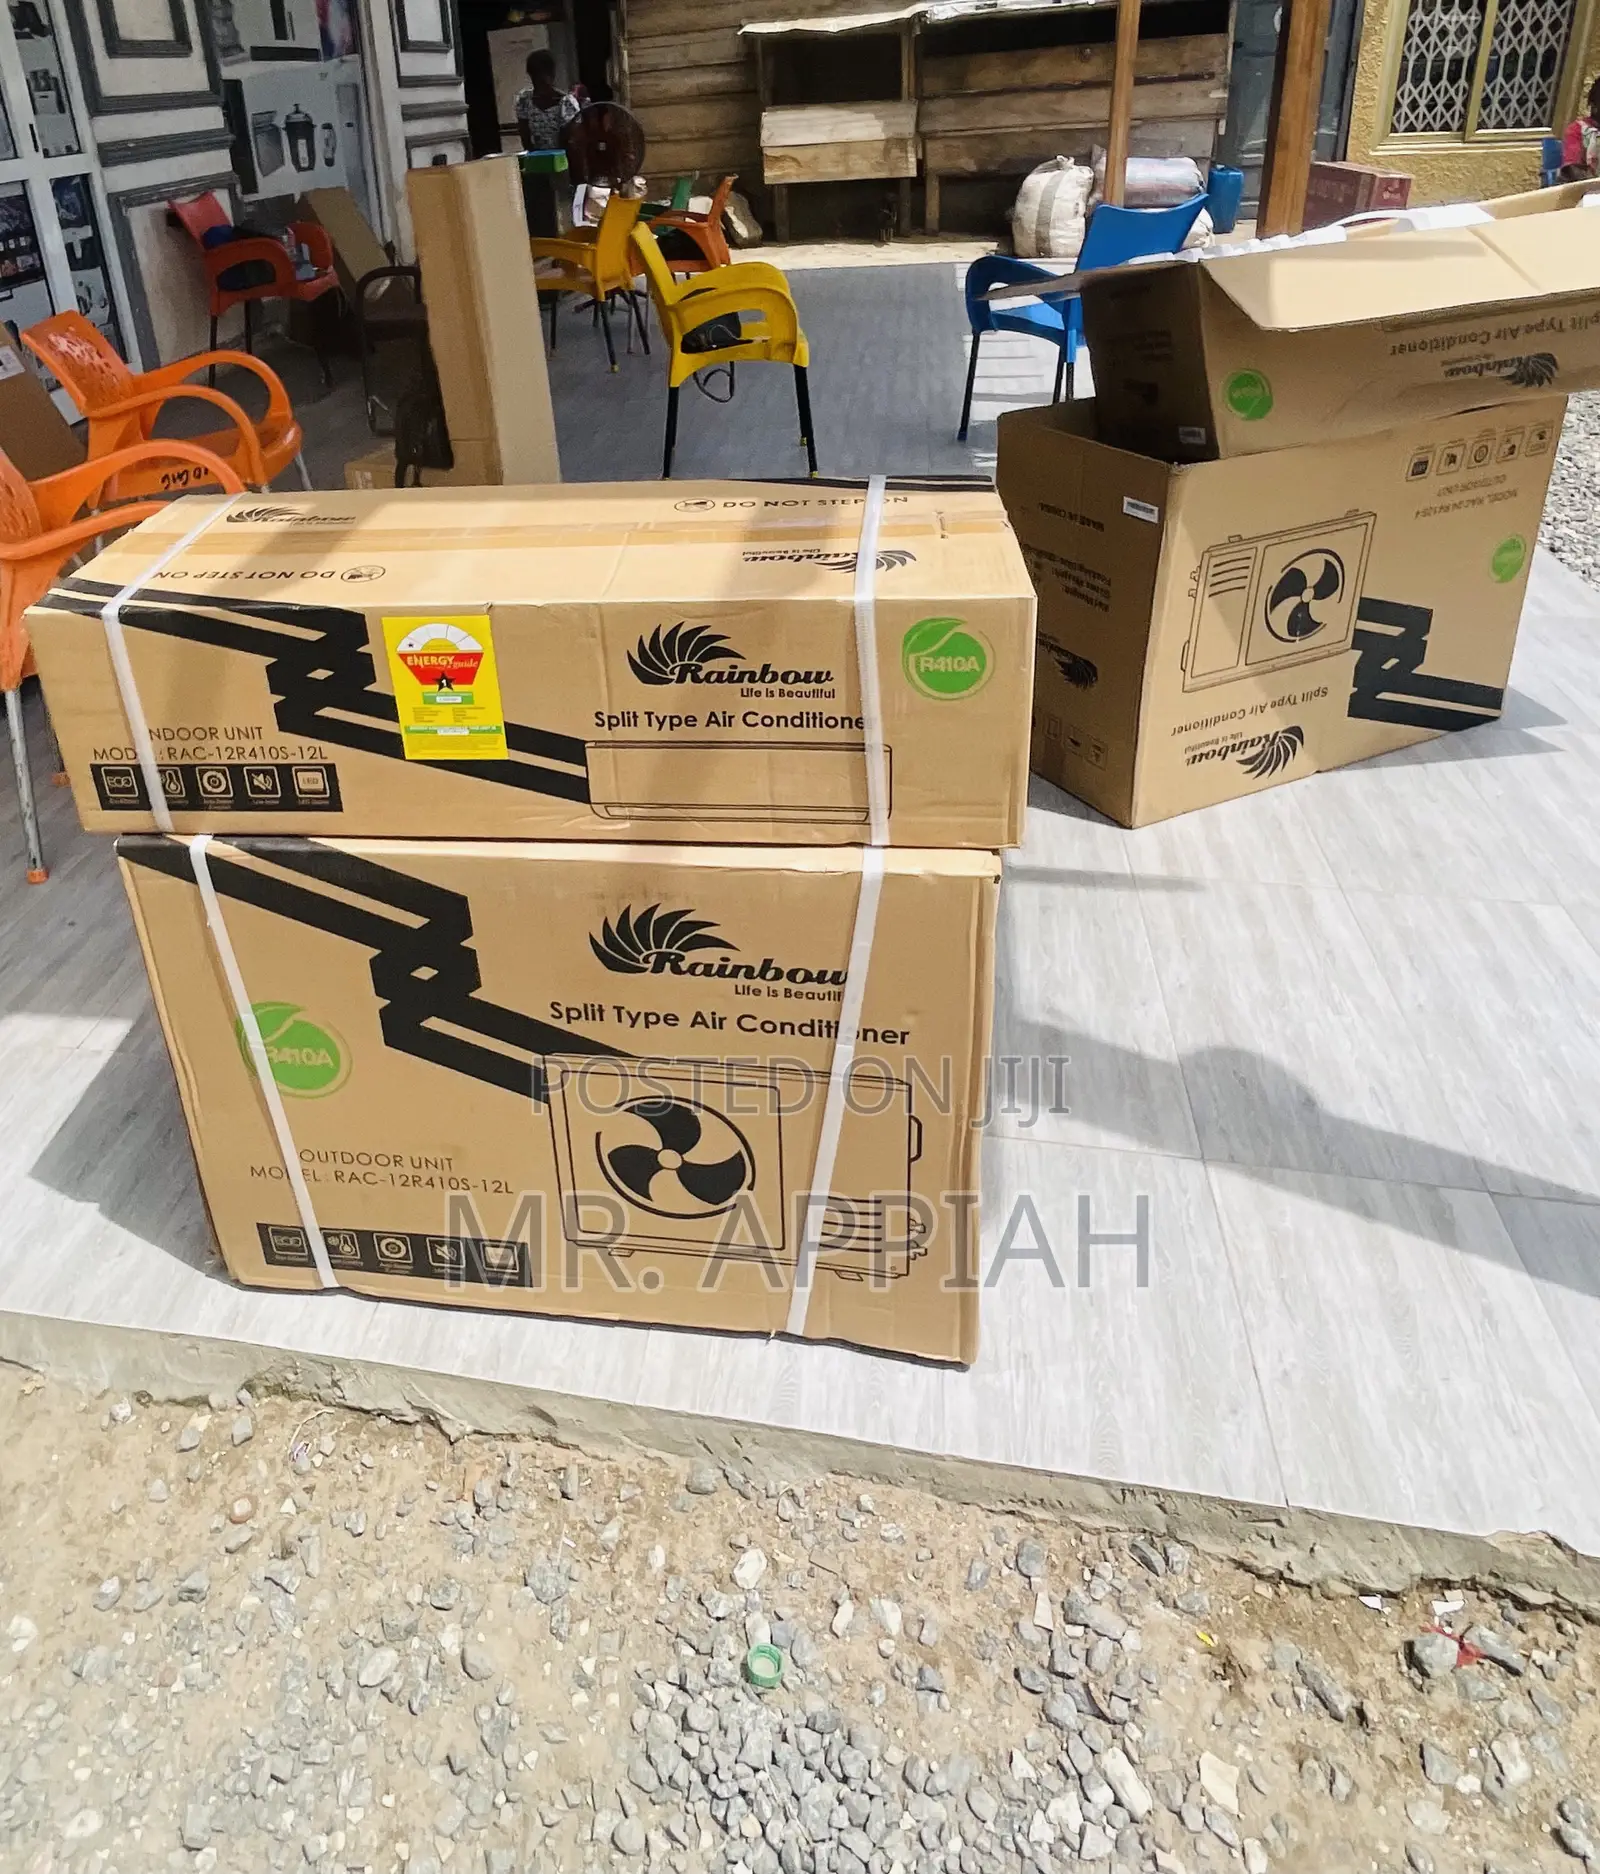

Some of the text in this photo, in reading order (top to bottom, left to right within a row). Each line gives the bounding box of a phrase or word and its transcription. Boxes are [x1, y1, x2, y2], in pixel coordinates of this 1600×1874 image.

[1495, 326, 1521, 341] Air
[1525, 316, 1565, 336] Type
[1390, 329, 1491, 357] Conditioner
[723, 500, 756, 508] DO
[763, 499, 811, 508] NOT
[818, 498, 866, 506] STEP
[151, 570, 336, 580] DO NOT STEP ON
[406, 653, 479, 669] ENERGY guide
[919, 656, 980, 673] R410A
[441, 678, 447, 688] 1
[671, 662, 834, 685] Rainbow
[740, 687, 835, 699] Life is Beautiful
[594, 710, 865, 731] Split Type Air Conditione
[1170, 686, 1328, 737] Split Type Air Conditioner
[148, 726, 263, 741] NDOOR UNIT
[93, 746, 328, 761] MOD: RAC-12R410S-12L
[1184, 731, 1281, 768] Rainbow
[107, 776, 132, 788] ECO
[644, 949, 848, 986] Rainbow
[734, 983, 842, 1002] Life is Beautif
[550, 1000, 910, 1045] Split Type Air Conditiner
[299, 1148, 454, 1171] OUTDOOR UNIT
[250, 1165, 515, 1195] MOEL: RAC-12R410S-12L
